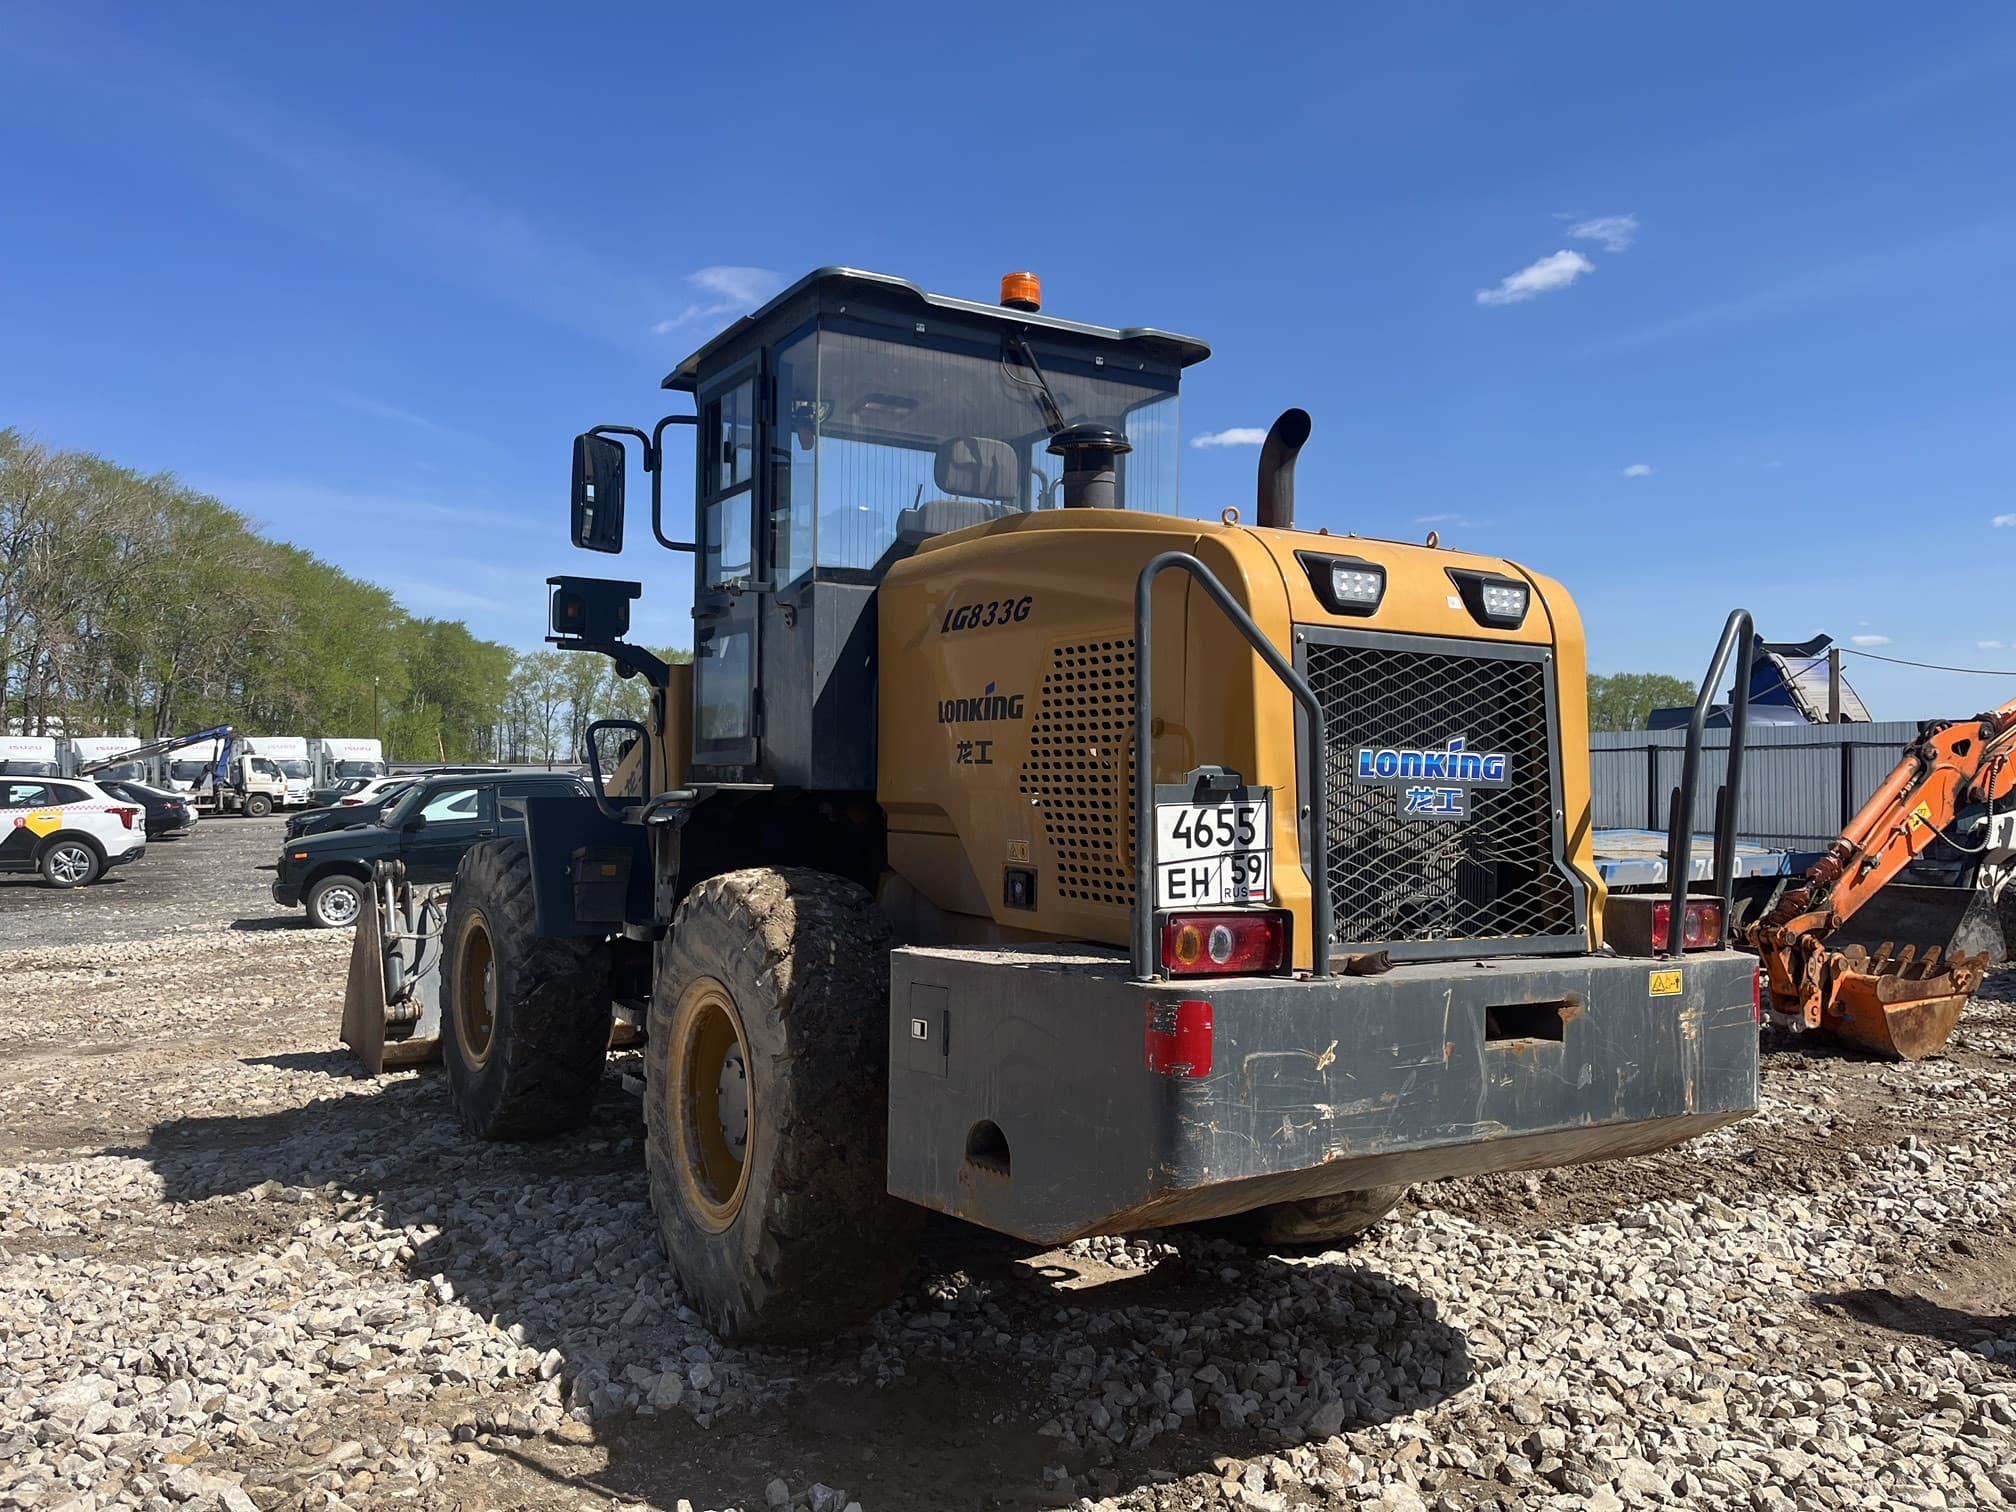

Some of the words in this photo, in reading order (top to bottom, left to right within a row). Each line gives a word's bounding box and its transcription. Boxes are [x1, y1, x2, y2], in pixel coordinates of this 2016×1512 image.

[940, 595, 1033, 634] LG833G
[956, 740, 993, 765] 龙工
[1404, 785, 1465, 816] 龙工
[1172, 807, 1256, 849] 4655
[1231, 854, 1262, 885] 59
[1224, 886, 1248, 898] RUS
